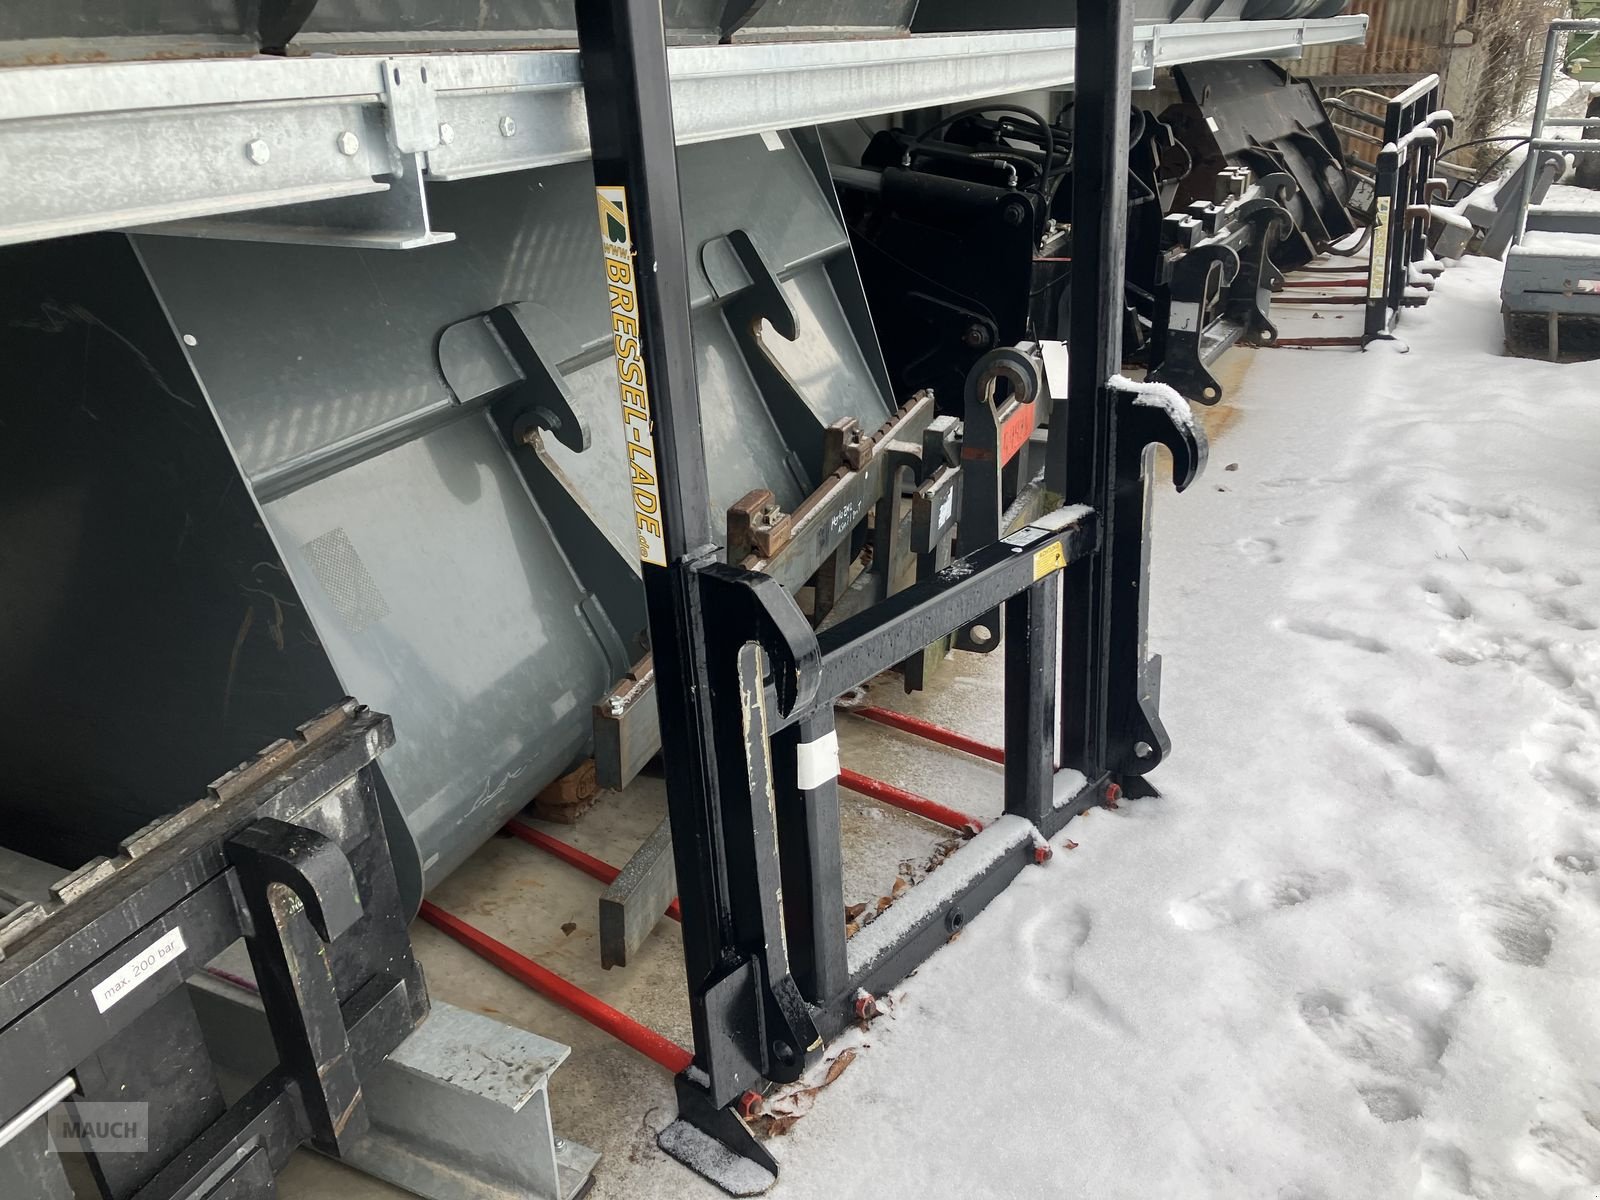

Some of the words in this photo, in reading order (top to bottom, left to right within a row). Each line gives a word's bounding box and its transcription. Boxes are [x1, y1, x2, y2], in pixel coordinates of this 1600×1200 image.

[104, 978, 132, 999] max.
[132, 955, 156, 978] 200
[158, 941, 175, 958] bar
